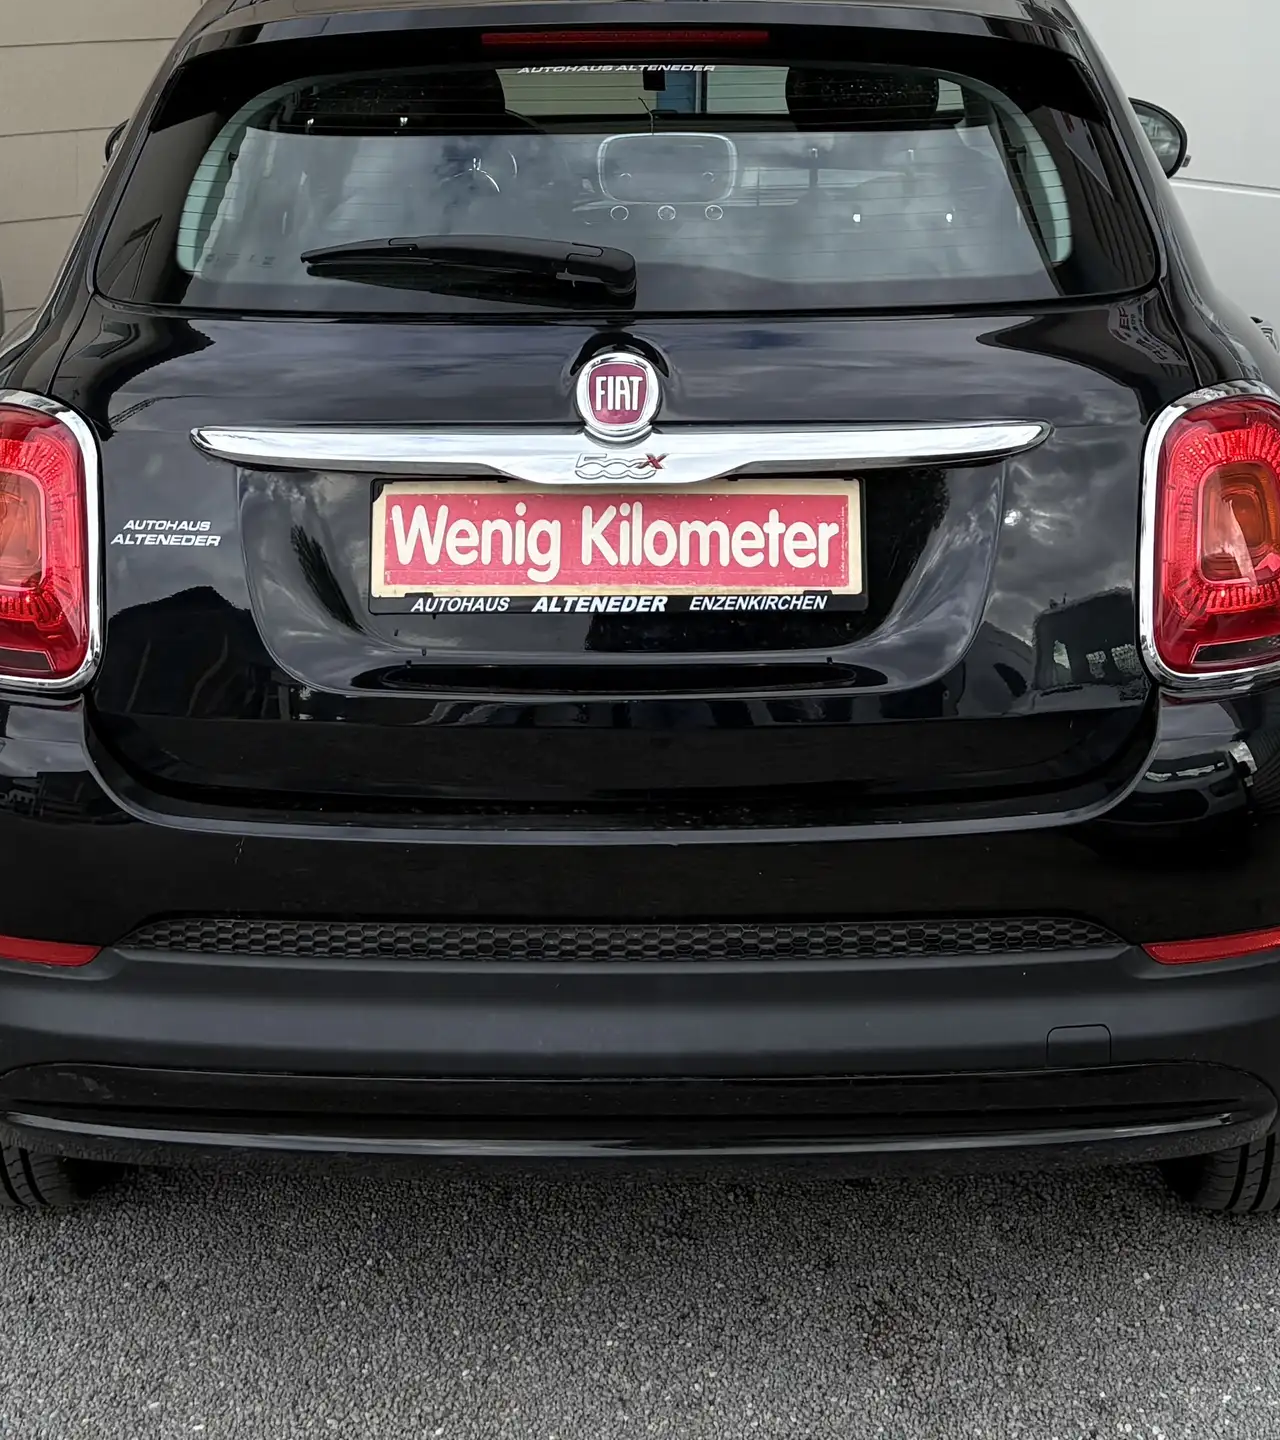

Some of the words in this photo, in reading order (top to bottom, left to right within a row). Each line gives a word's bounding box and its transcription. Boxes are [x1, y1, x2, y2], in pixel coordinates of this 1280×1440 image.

[517, 65, 614, 74] AUTOHAUS
[614, 64, 716, 72] ALTENEDER
[595, 375, 644, 411] FIAT
[122, 520, 211, 531] AUTOHAUS
[110, 534, 221, 547] ALTENEDER
[390, 502, 561, 583] Wenig
[581, 501, 839, 569] Kilometer
[410, 597, 510, 613] AUTOHAUS
[531, 596, 669, 613] ALTENEDER
[689, 595, 828, 611] ENZENKIRCHEN
